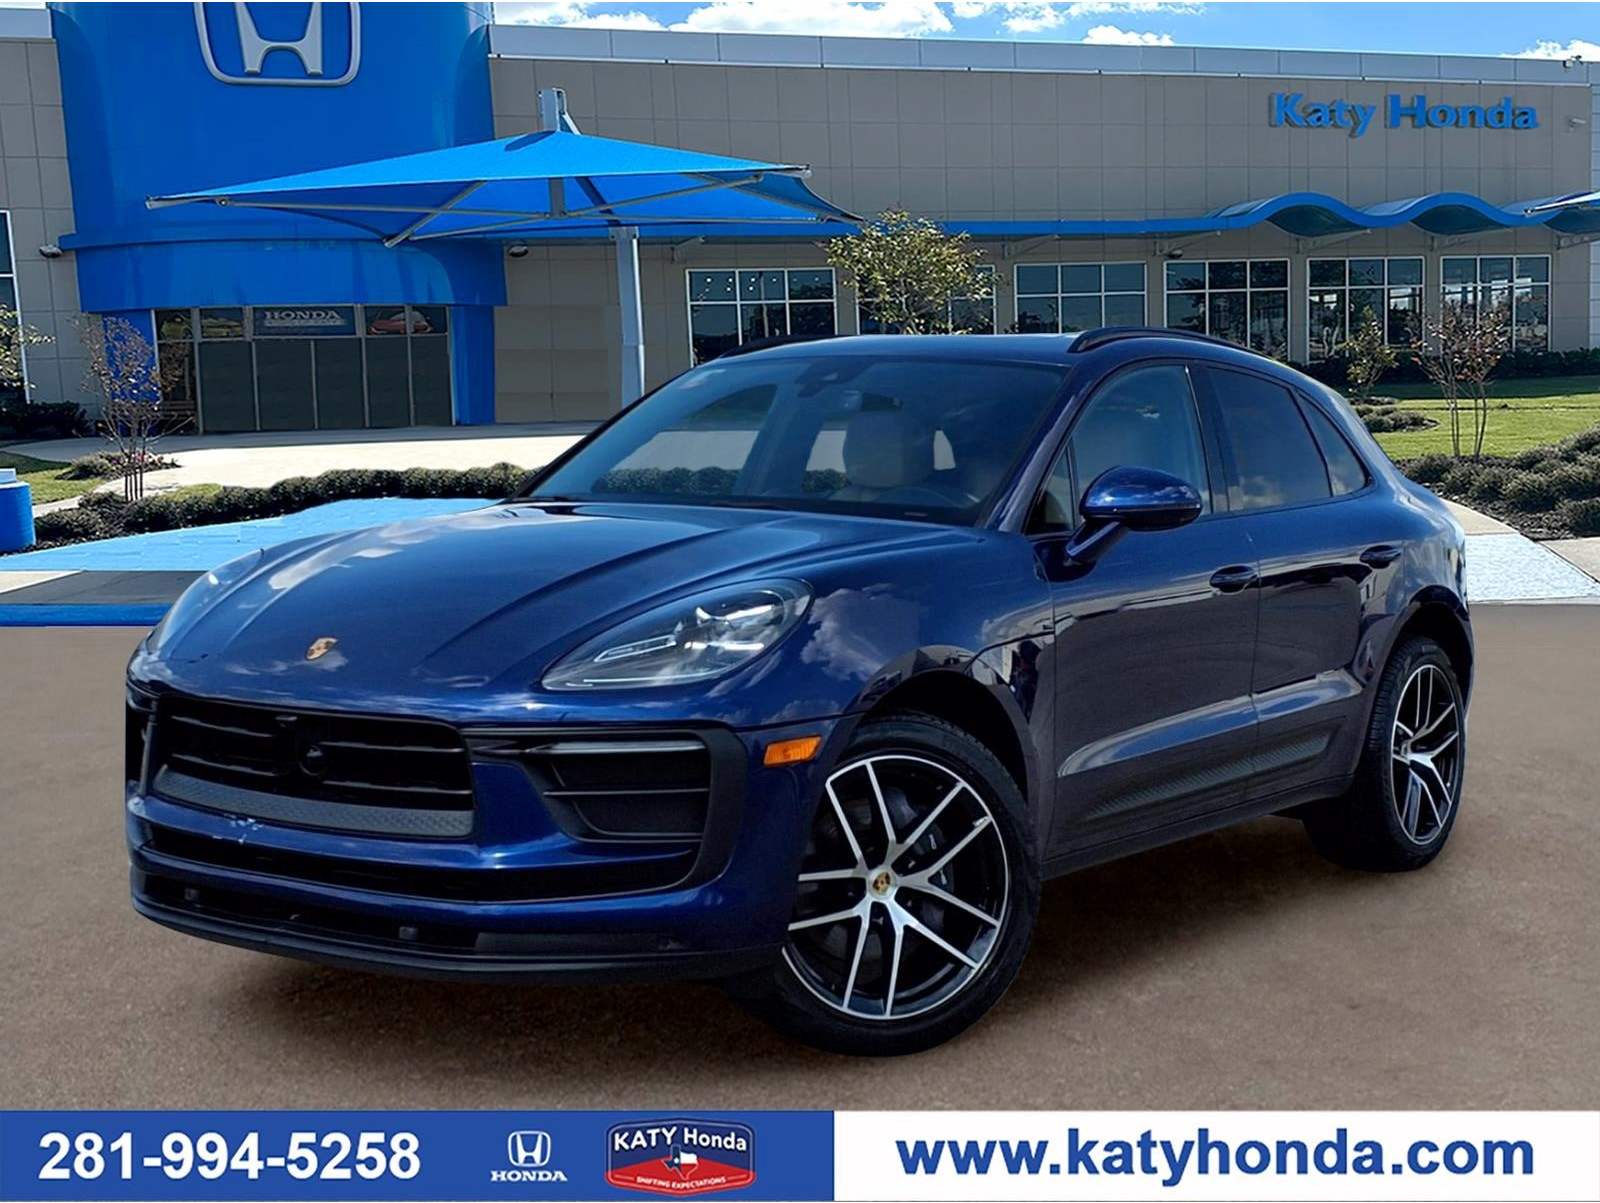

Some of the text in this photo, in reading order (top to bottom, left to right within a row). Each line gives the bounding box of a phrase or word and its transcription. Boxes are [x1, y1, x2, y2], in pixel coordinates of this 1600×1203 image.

[1270, 92, 1539, 138] Katy Honda
[264, 310, 341, 320] HONDA
